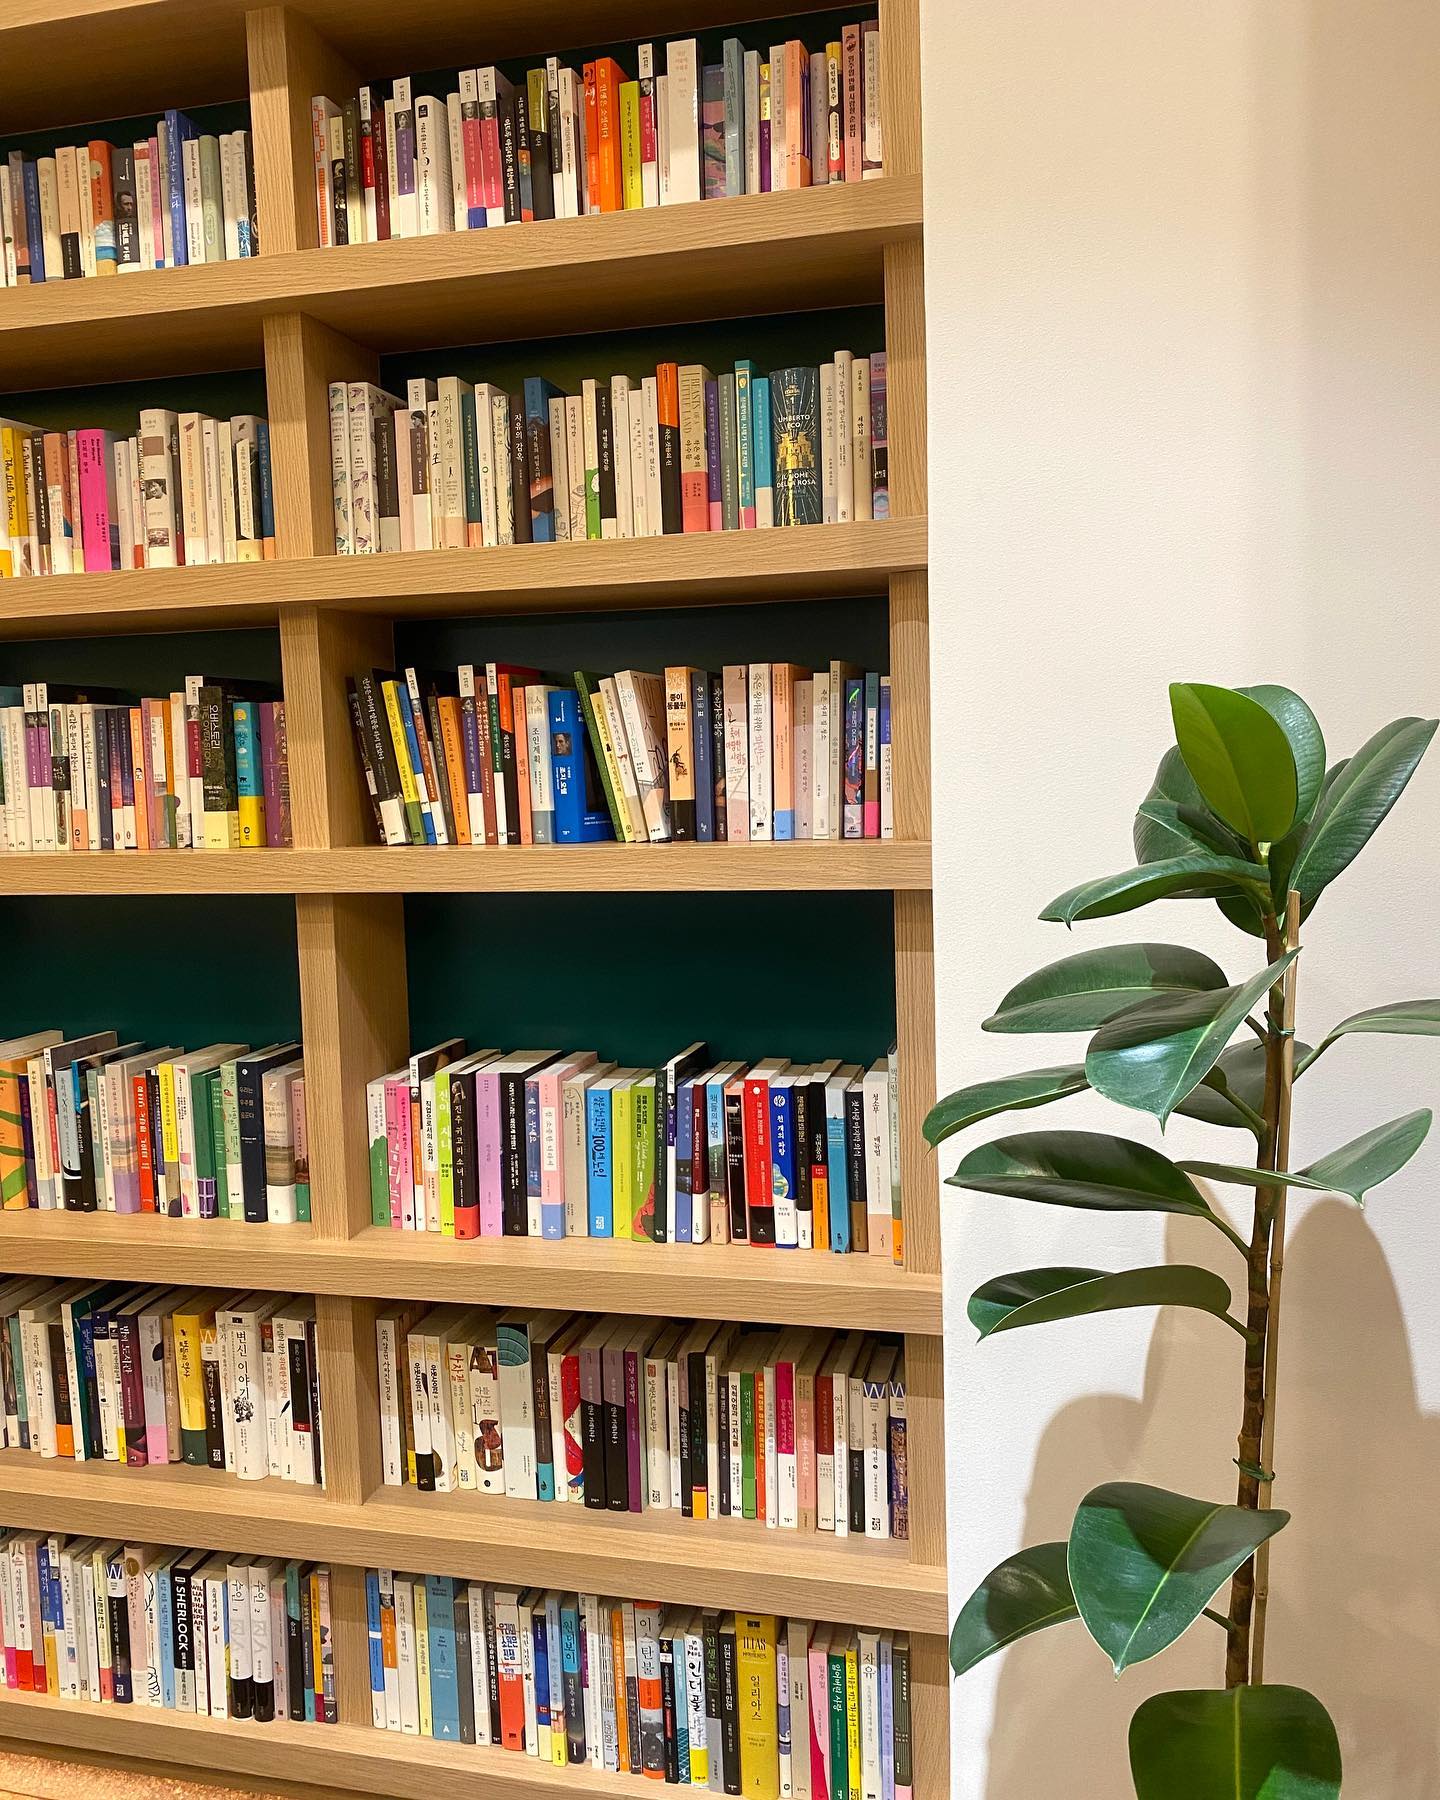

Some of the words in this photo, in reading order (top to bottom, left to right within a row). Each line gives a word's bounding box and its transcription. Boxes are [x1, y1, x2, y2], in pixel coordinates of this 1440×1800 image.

[600, 84, 608, 107] 인생은
[681, 378, 690, 408] LITTLE
[691, 378, 701, 410] BEASTS
[682, 411, 692, 433] LAND
[5, 458, 13, 471] The
[5, 474, 14, 493] Little
[7, 496, 15, 520] Prince
[753, 673, 762, 689] 죽은
[667, 702, 686, 710] 동물원
[669, 693, 683, 701] 종이
[753, 691, 763, 714] 왕녀를
[209, 704, 220, 749] 오버스토리
[754, 716, 764, 732] 위한
[560, 767, 566, 780] 조지
[560, 782, 567, 795] 오웰
[852, 1099, 860, 1120] 첫사랑
[777, 1125, 784, 1139] 개의
[853, 1122, 861, 1142] 마지막
[778, 1141, 786, 1156] 파랑
[853, 1143, 861, 1157] 의식
[592, 1161, 607, 1178] 노인
[120, 1325, 129, 1342] 밤의
[179, 1340, 188, 1360] 벌들의
[237, 1331, 247, 1357] 변신
[122, 1344, 132, 1374] 도서관
[182, 1362, 190, 1378] 역사
[238, 1360, 249, 1399] 이야기
[430, 1364, 438, 1394] 아웃사이더
[232, 1580, 244, 1602] 수인
[254, 1580, 266, 1602] 수인
[175, 1586, 188, 1651] SHERLOCK
[863, 1653, 875, 1679] 자유
[751, 1675, 761, 1720] 일리아스
[833, 1696, 843, 1712] 사랑
